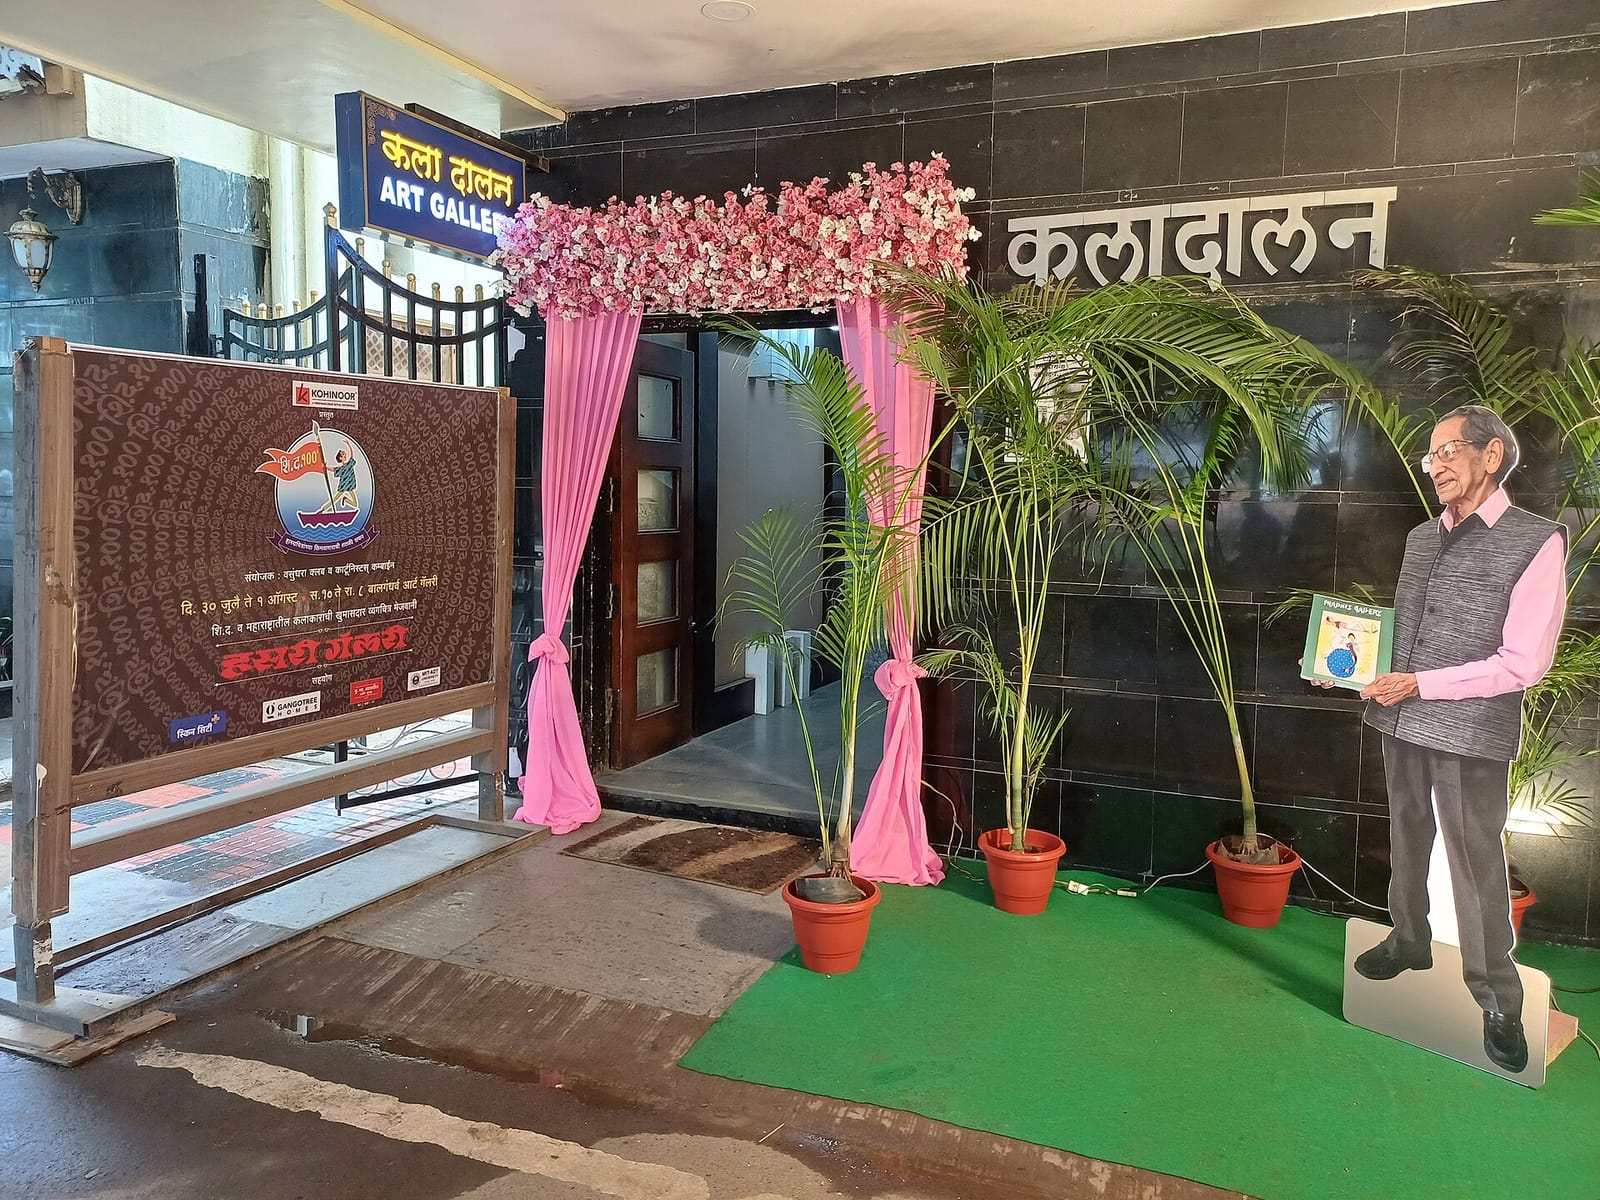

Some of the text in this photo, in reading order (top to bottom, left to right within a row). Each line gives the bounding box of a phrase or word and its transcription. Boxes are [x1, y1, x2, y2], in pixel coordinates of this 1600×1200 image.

[380, 130, 513, 207] कला दालन
[380, 176, 506, 237] ART GALLER
[1008, 186, 1398, 292] कलादालन
[311, 389, 355, 400] KOHINOOR
[244, 570, 275, 583] संयोजक
[283, 567, 307, 582] वसुंधरा
[181, 600, 197, 616] दि.
[202, 601, 217, 614] ३०
[220, 594, 241, 615] जुलै
[244, 593, 254, 608] ते
[257, 595, 264, 608] १
[267, 590, 299, 606] ऑगस्ट
[334, 584, 342, 598] ते
[402, 576, 419, 590] आर्ट
[420, 574, 439, 588] गॅलरी
[237, 623, 244, 633] व
[246, 616, 291, 633] महाराष्ट्रातील
[292, 609, 334, 626] कलाकारांची
[335, 607, 367, 623] खुमासदार
[220, 624, 409, 678] हसरी गॅलरी
[277, 697, 319, 711] GANGOTREE
[176, 721, 213, 740] स्किन सिटी
